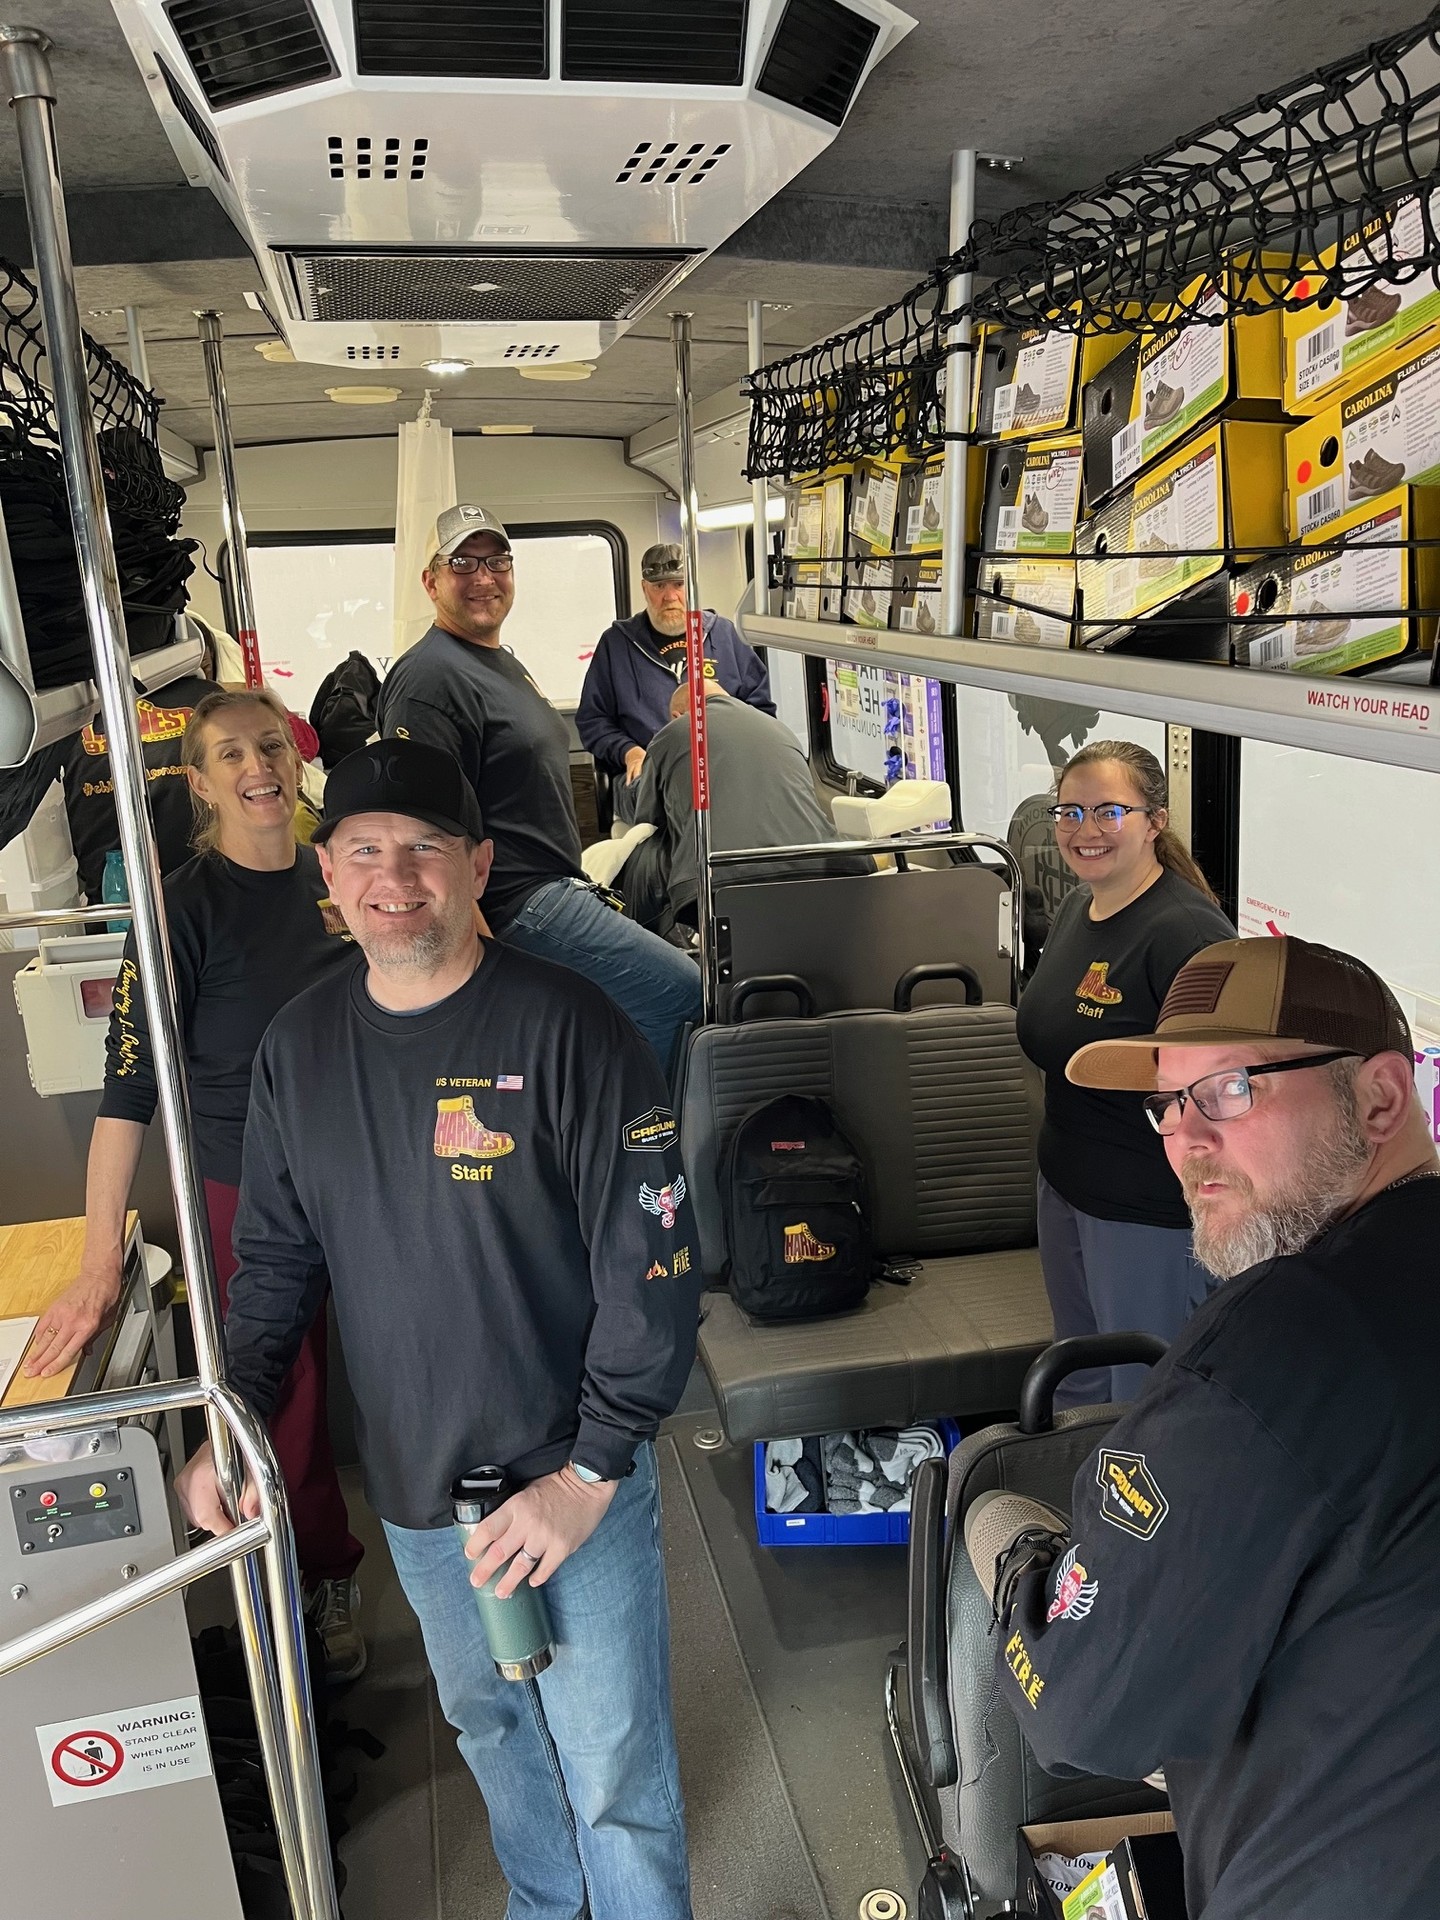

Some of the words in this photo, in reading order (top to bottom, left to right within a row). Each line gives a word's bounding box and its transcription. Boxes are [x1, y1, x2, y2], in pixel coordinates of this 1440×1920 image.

[1343, 210, 1392, 252] CAOLIA
[1396, 193, 1414, 208] FLU
[1142, 327, 1179, 364] CAROLINA
[1344, 382, 1393, 419] CAROLINA
[1134, 482, 1170, 513] CAROLINA
[1344, 520, 1371, 540] AZALEA
[1294, 541, 1340, 571] CAROLIN
[245, 638, 258, 689] WATC
[690, 618, 701, 680] WATCH
[696, 695, 704, 742] YOUR
[1307, 690, 1350, 710] WATCH
[1353, 696, 1388, 716] YOUR
[1391, 701, 1430, 721] HEAD
[1247, 896, 1278, 914] EMERGENCY
[1279, 909, 1290, 919] EXIT
[1076, 1002, 1104, 1019] Staff
[435, 1077, 447, 1087] US
[449, 1078, 492, 1088] VETERAN
[435, 1145, 459, 1156] 912
[450, 1163, 493, 1181] Staff
[785, 1233, 834, 1257] HARVEST
[673, 1251, 690, 1275] FIRE
[1006, 1635, 1042, 1703] FIRE
[117, 1711, 196, 1733] WARNING:
[125, 1734, 159, 1746] STAND
[162, 1726, 197, 1739] CLEAR
[131, 1748, 163, 1760] WHEN
[166, 1741, 196, 1753] RAMP
[156, 1762, 166, 1770] IN
[169, 1757, 190, 1767] USE
